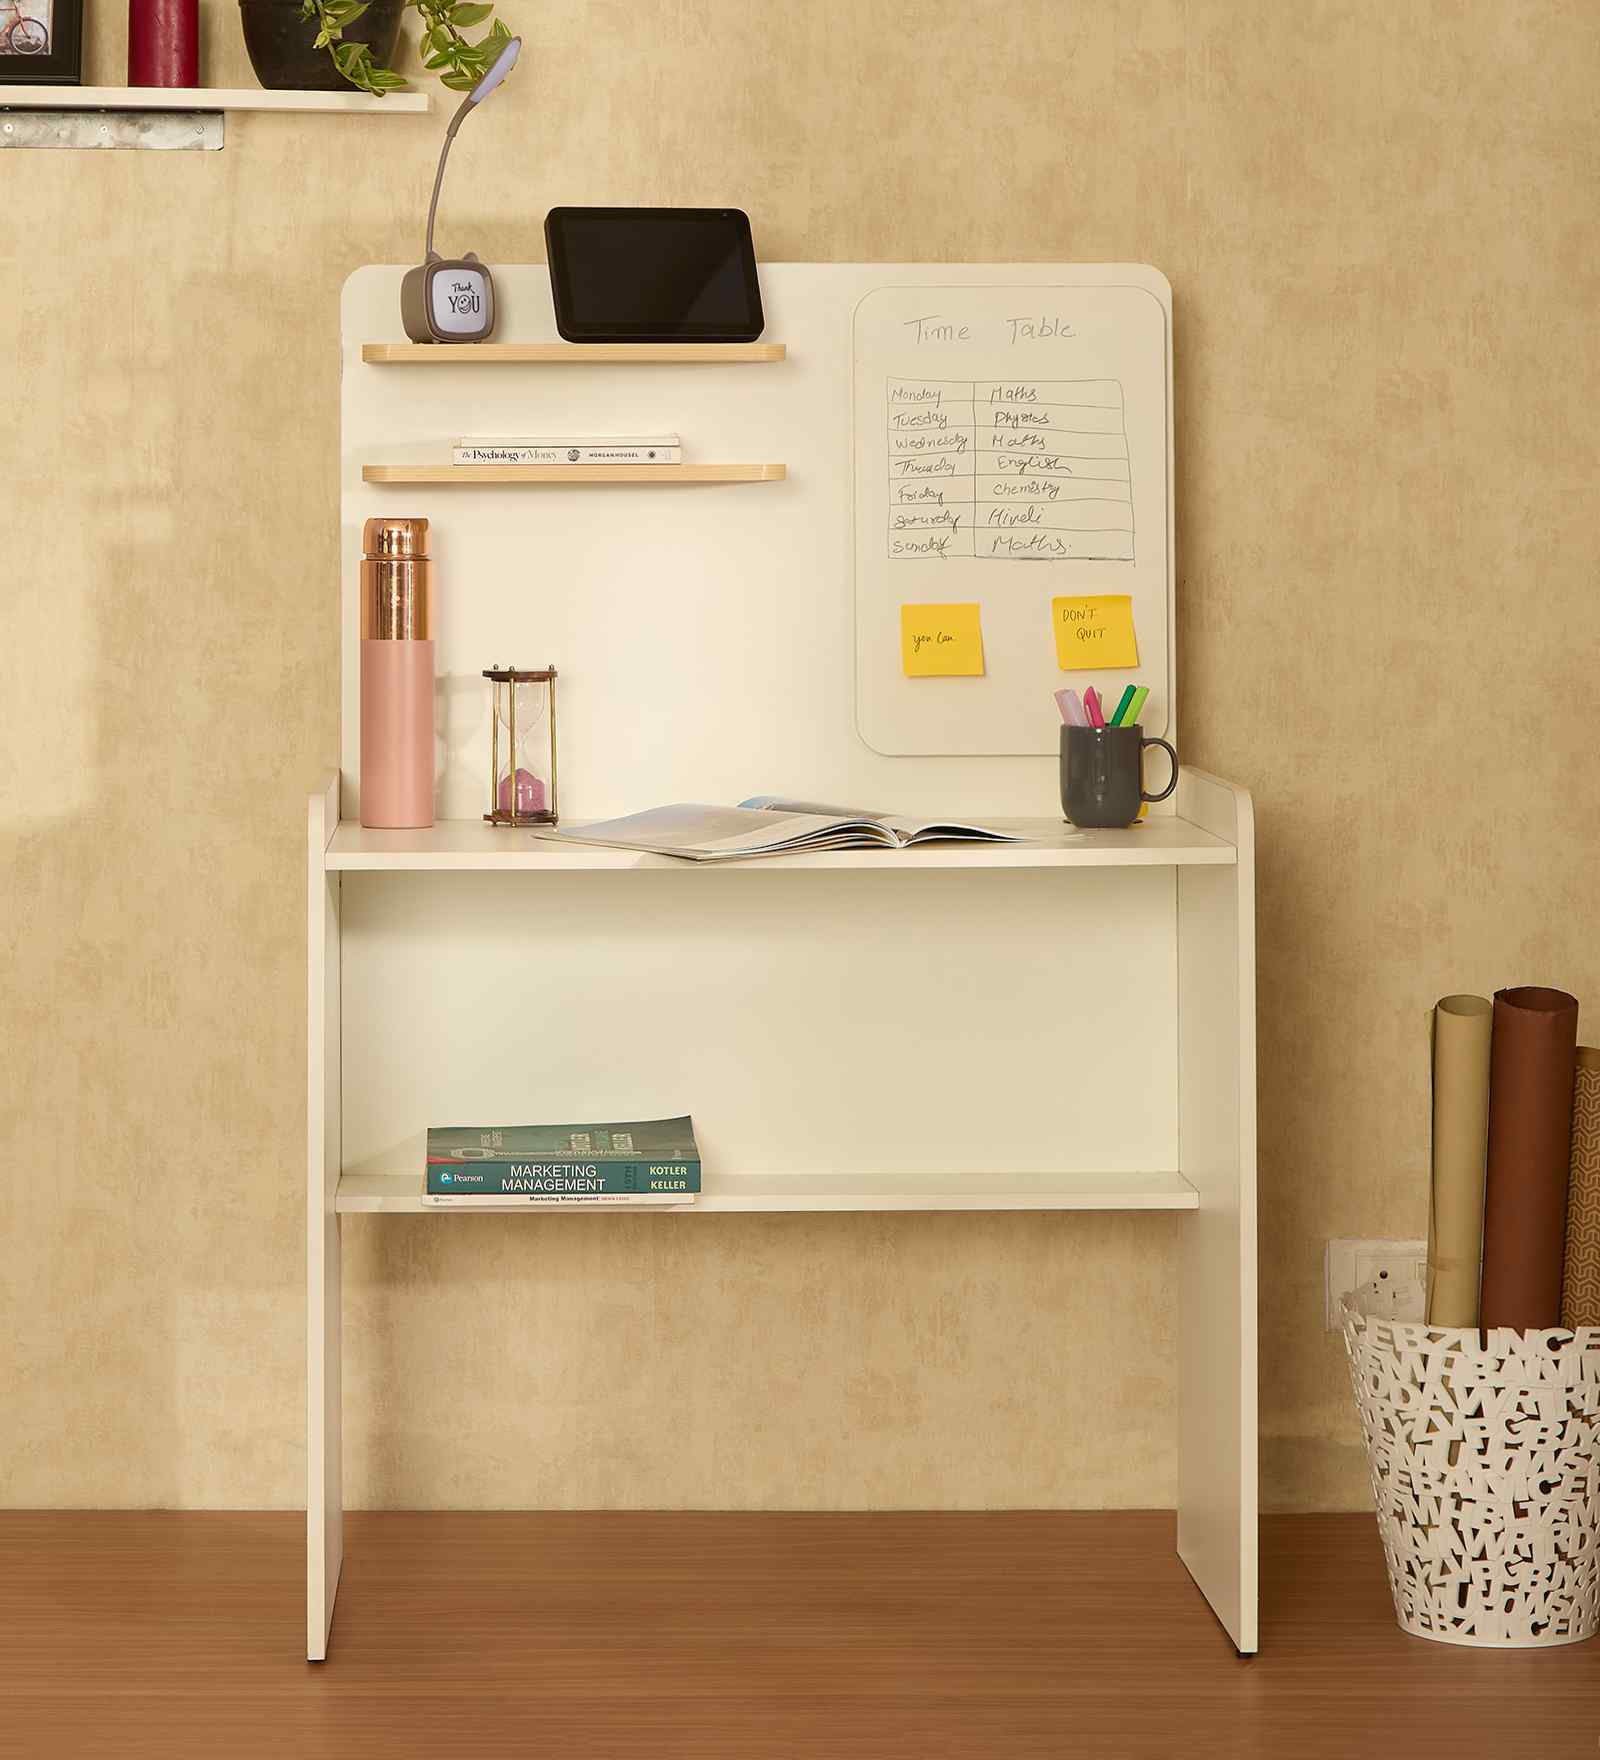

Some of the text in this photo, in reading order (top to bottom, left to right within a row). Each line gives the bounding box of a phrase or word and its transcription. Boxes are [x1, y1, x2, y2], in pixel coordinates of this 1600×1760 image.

[447, 294, 480, 314] YOU
[903, 315, 1077, 345] Time Table
[891, 387, 942, 408] Monday
[893, 410, 948, 430] Tuesday
[473, 449, 522, 463] Psychology
[527, 449, 557, 463] Money
[1076, 627, 1107, 642] QUIT
[510, 1165, 597, 1178] MARKETING
[649, 1165, 688, 1176] KOTLER
[453, 1173, 484, 1184] Pearson
[501, 1178, 606, 1191] MANAGEMENT
[649, 1180, 687, 1191] KELLER
[529, 1195, 560, 1203] Marketing
